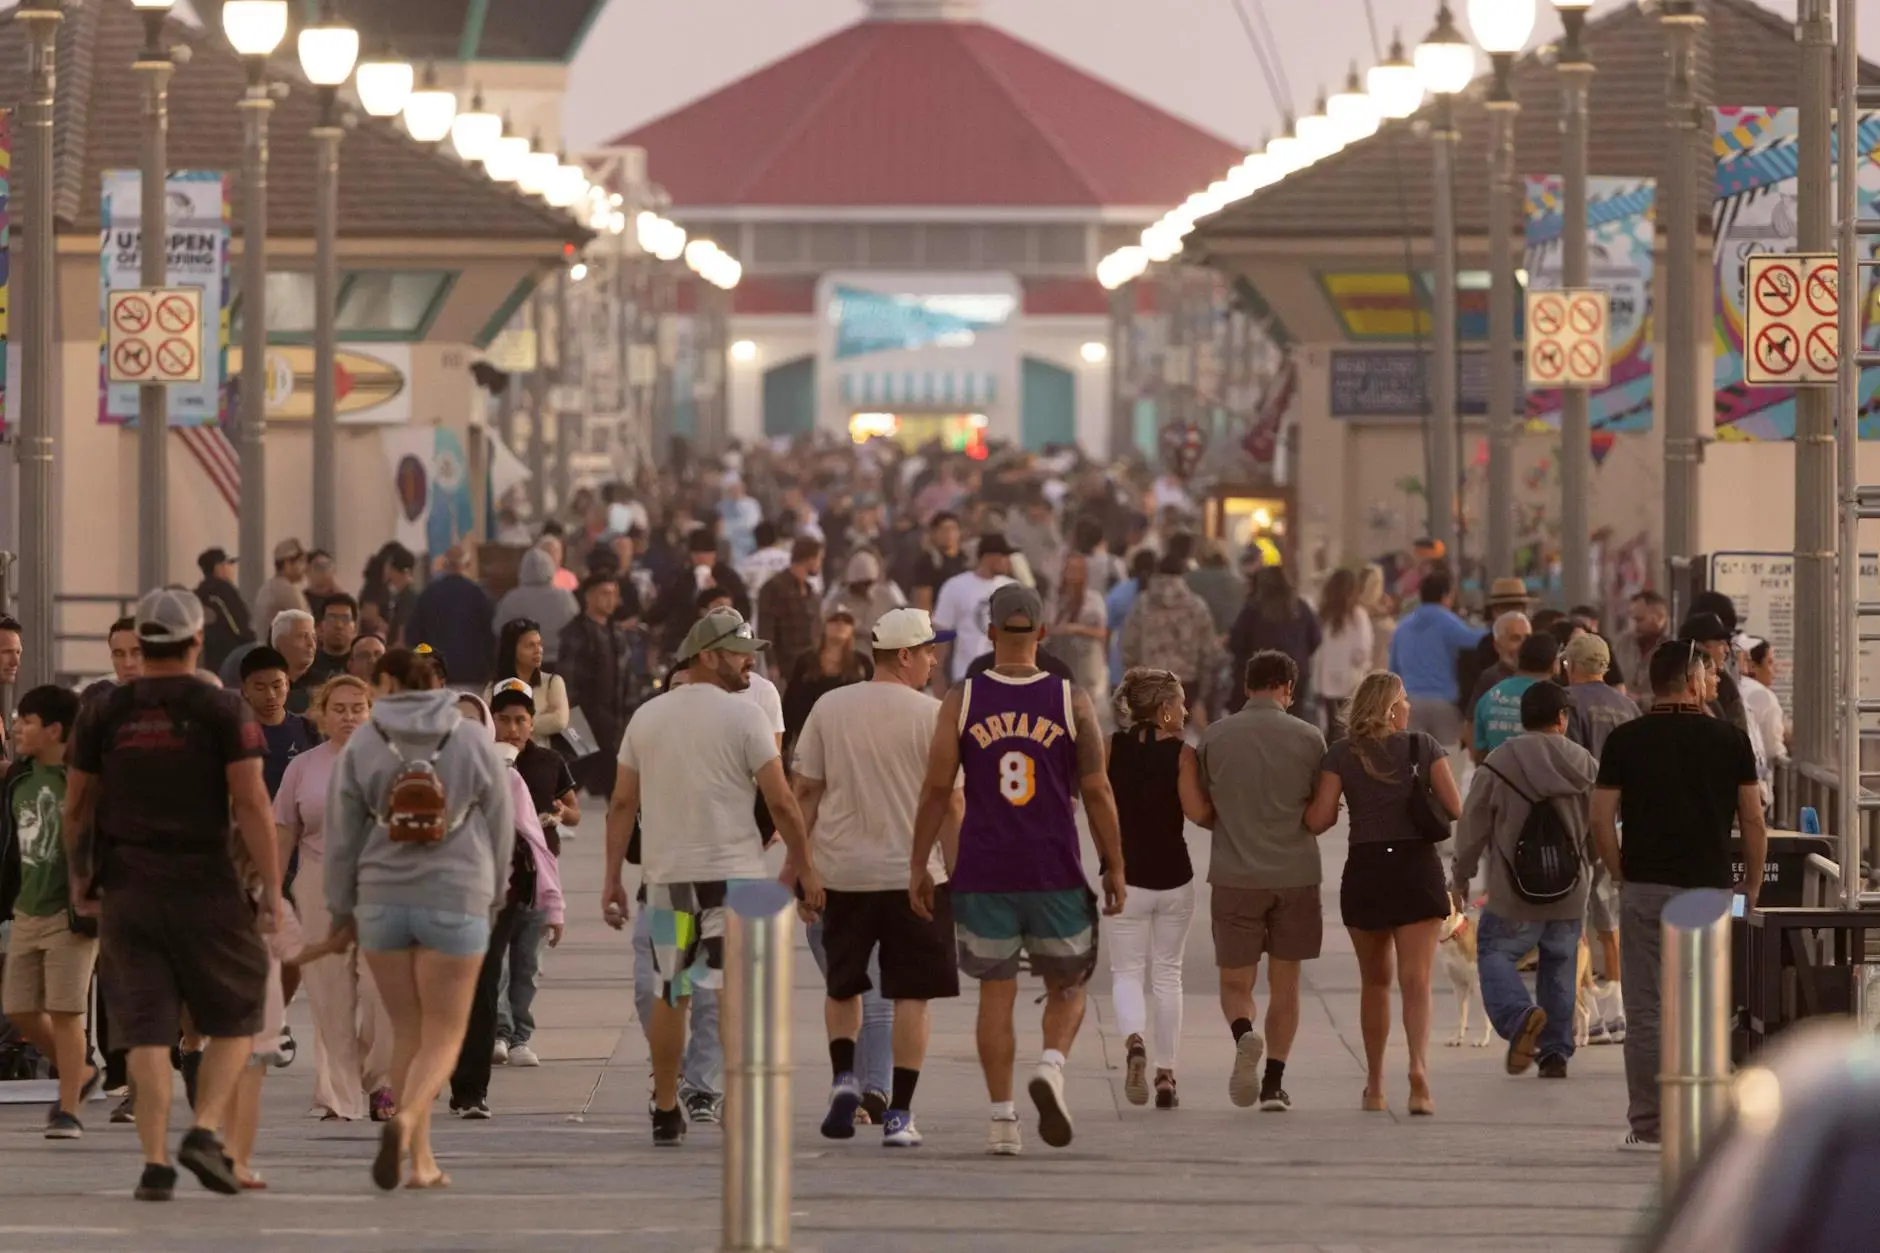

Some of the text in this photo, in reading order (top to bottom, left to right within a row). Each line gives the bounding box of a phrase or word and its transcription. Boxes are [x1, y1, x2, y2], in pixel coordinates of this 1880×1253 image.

[164, 232, 214, 250] PEN
[969, 711, 1065, 749] BRYANT
[999, 751, 1036, 806] 8
